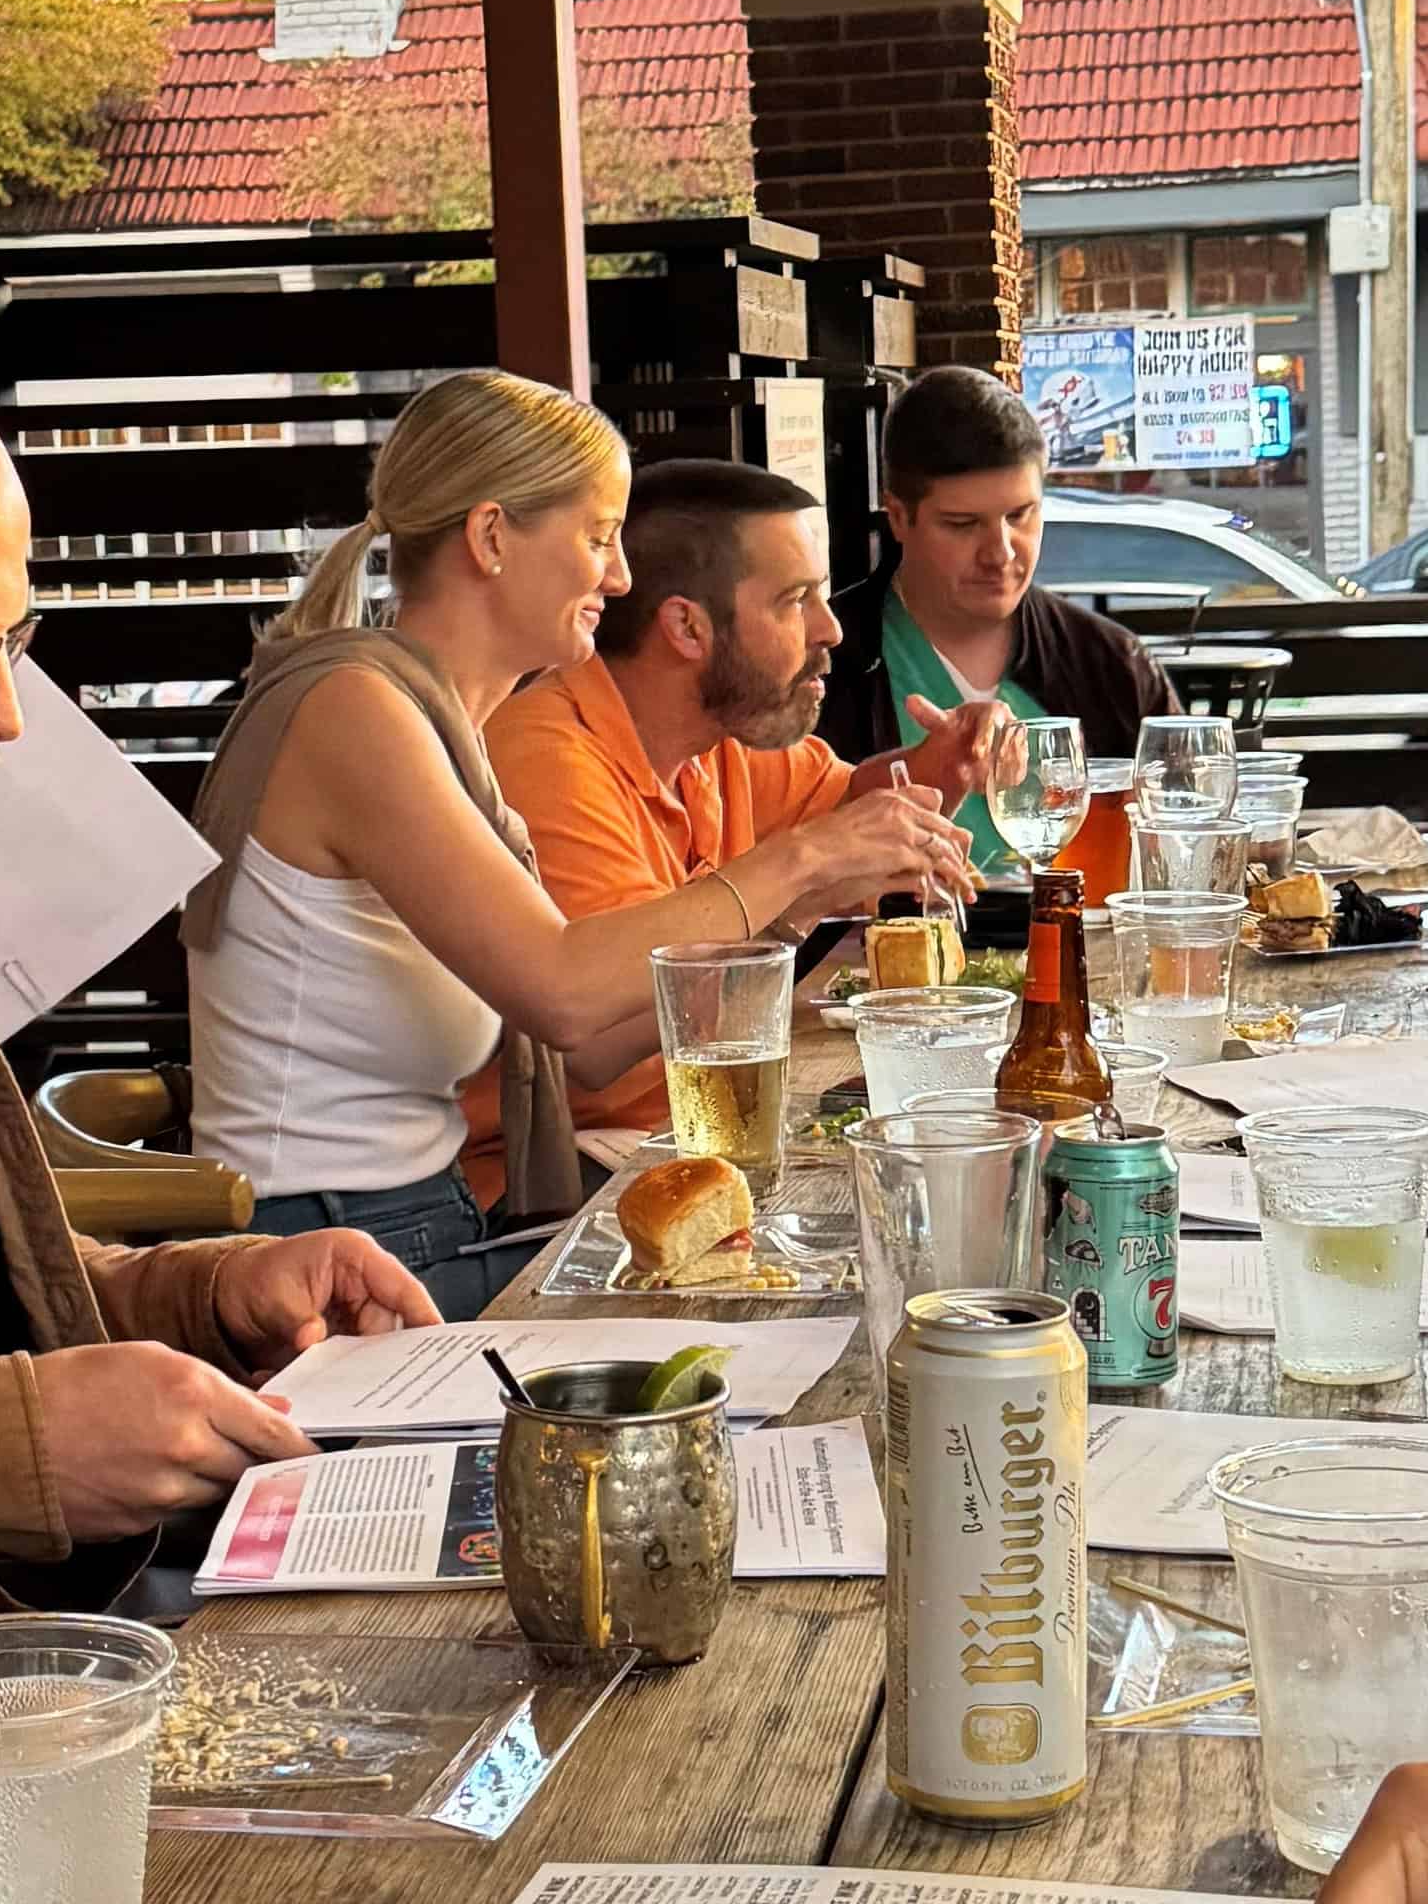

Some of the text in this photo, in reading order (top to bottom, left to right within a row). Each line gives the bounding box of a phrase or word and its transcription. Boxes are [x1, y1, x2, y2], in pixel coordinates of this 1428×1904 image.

[1144, 329, 1181, 351] JOIN
[1187, 328, 1208, 349] US
[1215, 326, 1246, 346] FOR
[1138, 355, 1194, 376] HAPPY
[1119, 1232, 1178, 1276] TAN
[958, 1402, 1056, 1688] Bitburger
[1053, 1547, 1078, 1644] Premium
